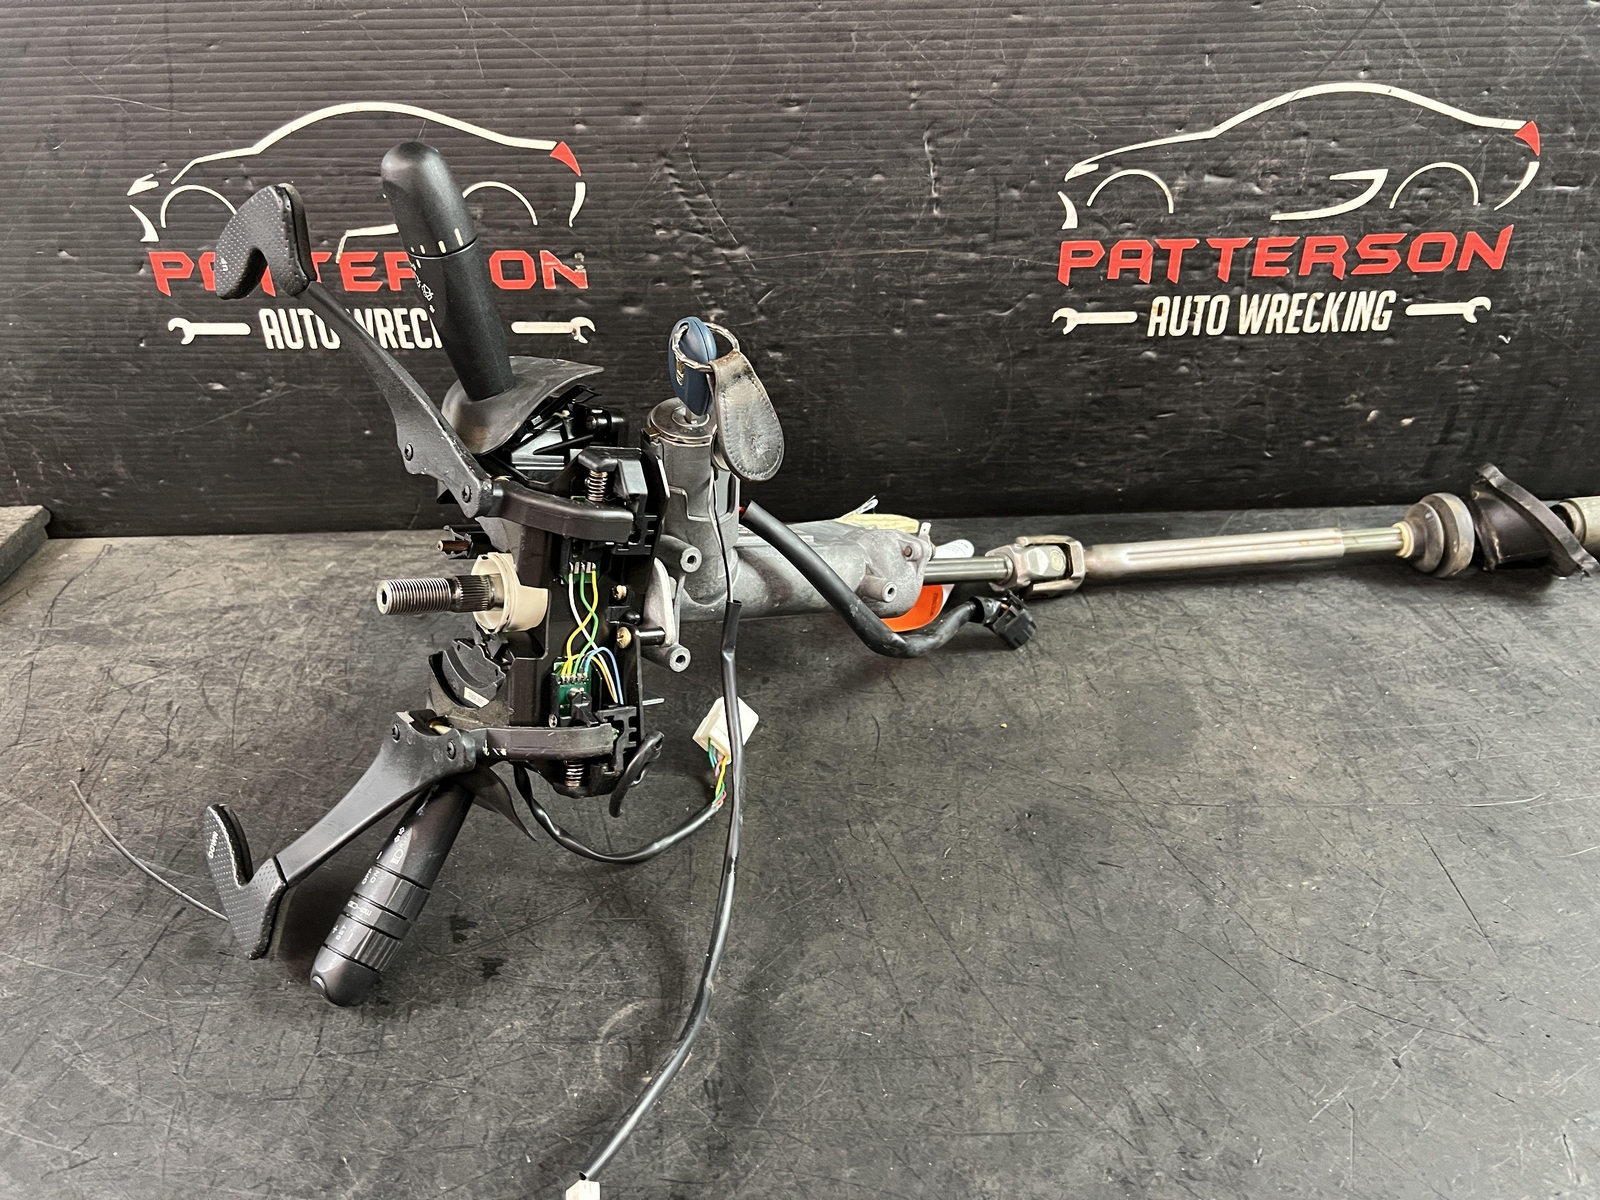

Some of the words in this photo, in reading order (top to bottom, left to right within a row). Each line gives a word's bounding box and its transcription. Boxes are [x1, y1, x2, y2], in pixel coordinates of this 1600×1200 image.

[1057, 225, 1514, 286] PATTERSON
[1148, 295, 1230, 339] AUTO
[1239, 290, 1396, 334] WRECKING
[208, 830, 219, 858] DOWN
[361, 868, 372, 885] OFF
[370, 870, 380, 883] ON
